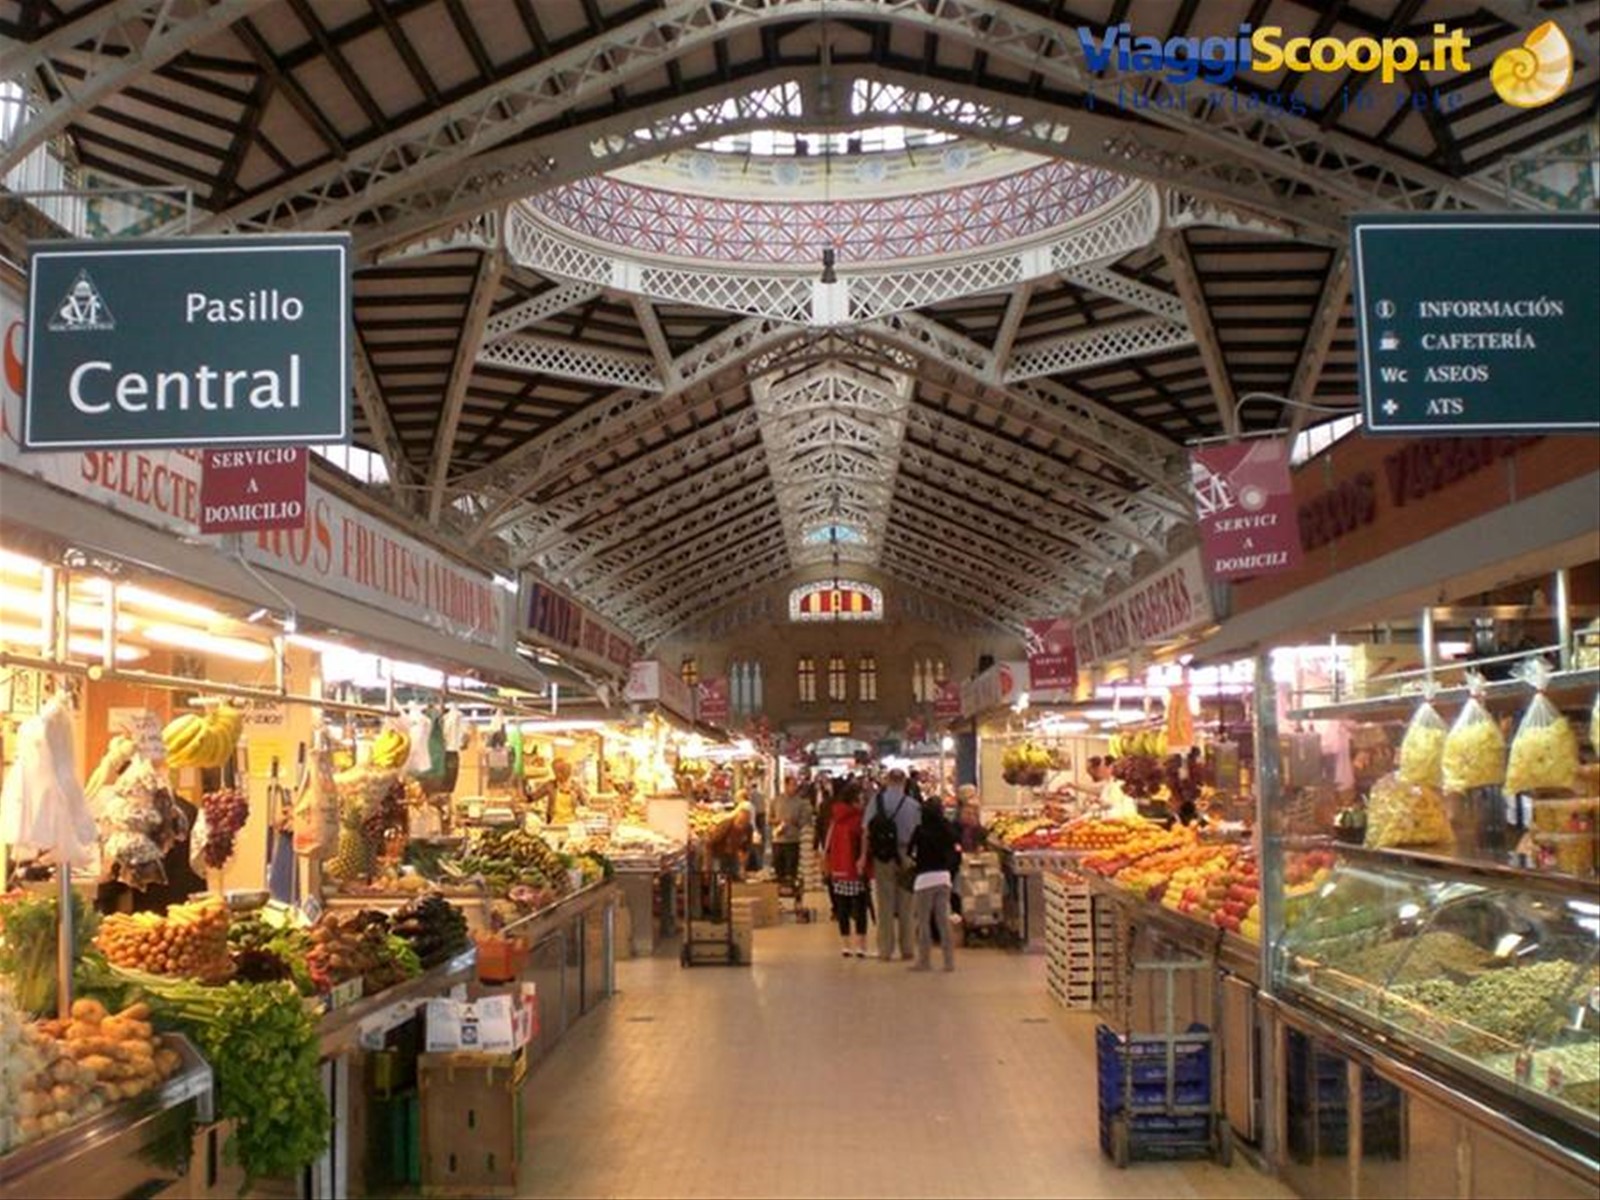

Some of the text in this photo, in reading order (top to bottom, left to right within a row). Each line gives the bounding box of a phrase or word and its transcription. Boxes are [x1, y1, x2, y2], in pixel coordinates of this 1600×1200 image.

[186, 290, 304, 323] Pasillo
[1419, 296, 1564, 318] INFORMACIÓN
[1421, 329, 1536, 350] CAFETERÍA
[69, 355, 300, 414] Central
[1424, 365, 1489, 383] ASEOS
[1426, 398, 1464, 415] ATS
[211, 447, 297, 469] SERVICIO
[81, 449, 200, 526] SELECTE
[246, 478, 259, 493] A
[204, 500, 302, 524] DOMICILIO
[1213, 513, 1278, 533] SERVICI
[1243, 536, 1254, 549] A
[1214, 550, 1289, 572] DOMICILI
